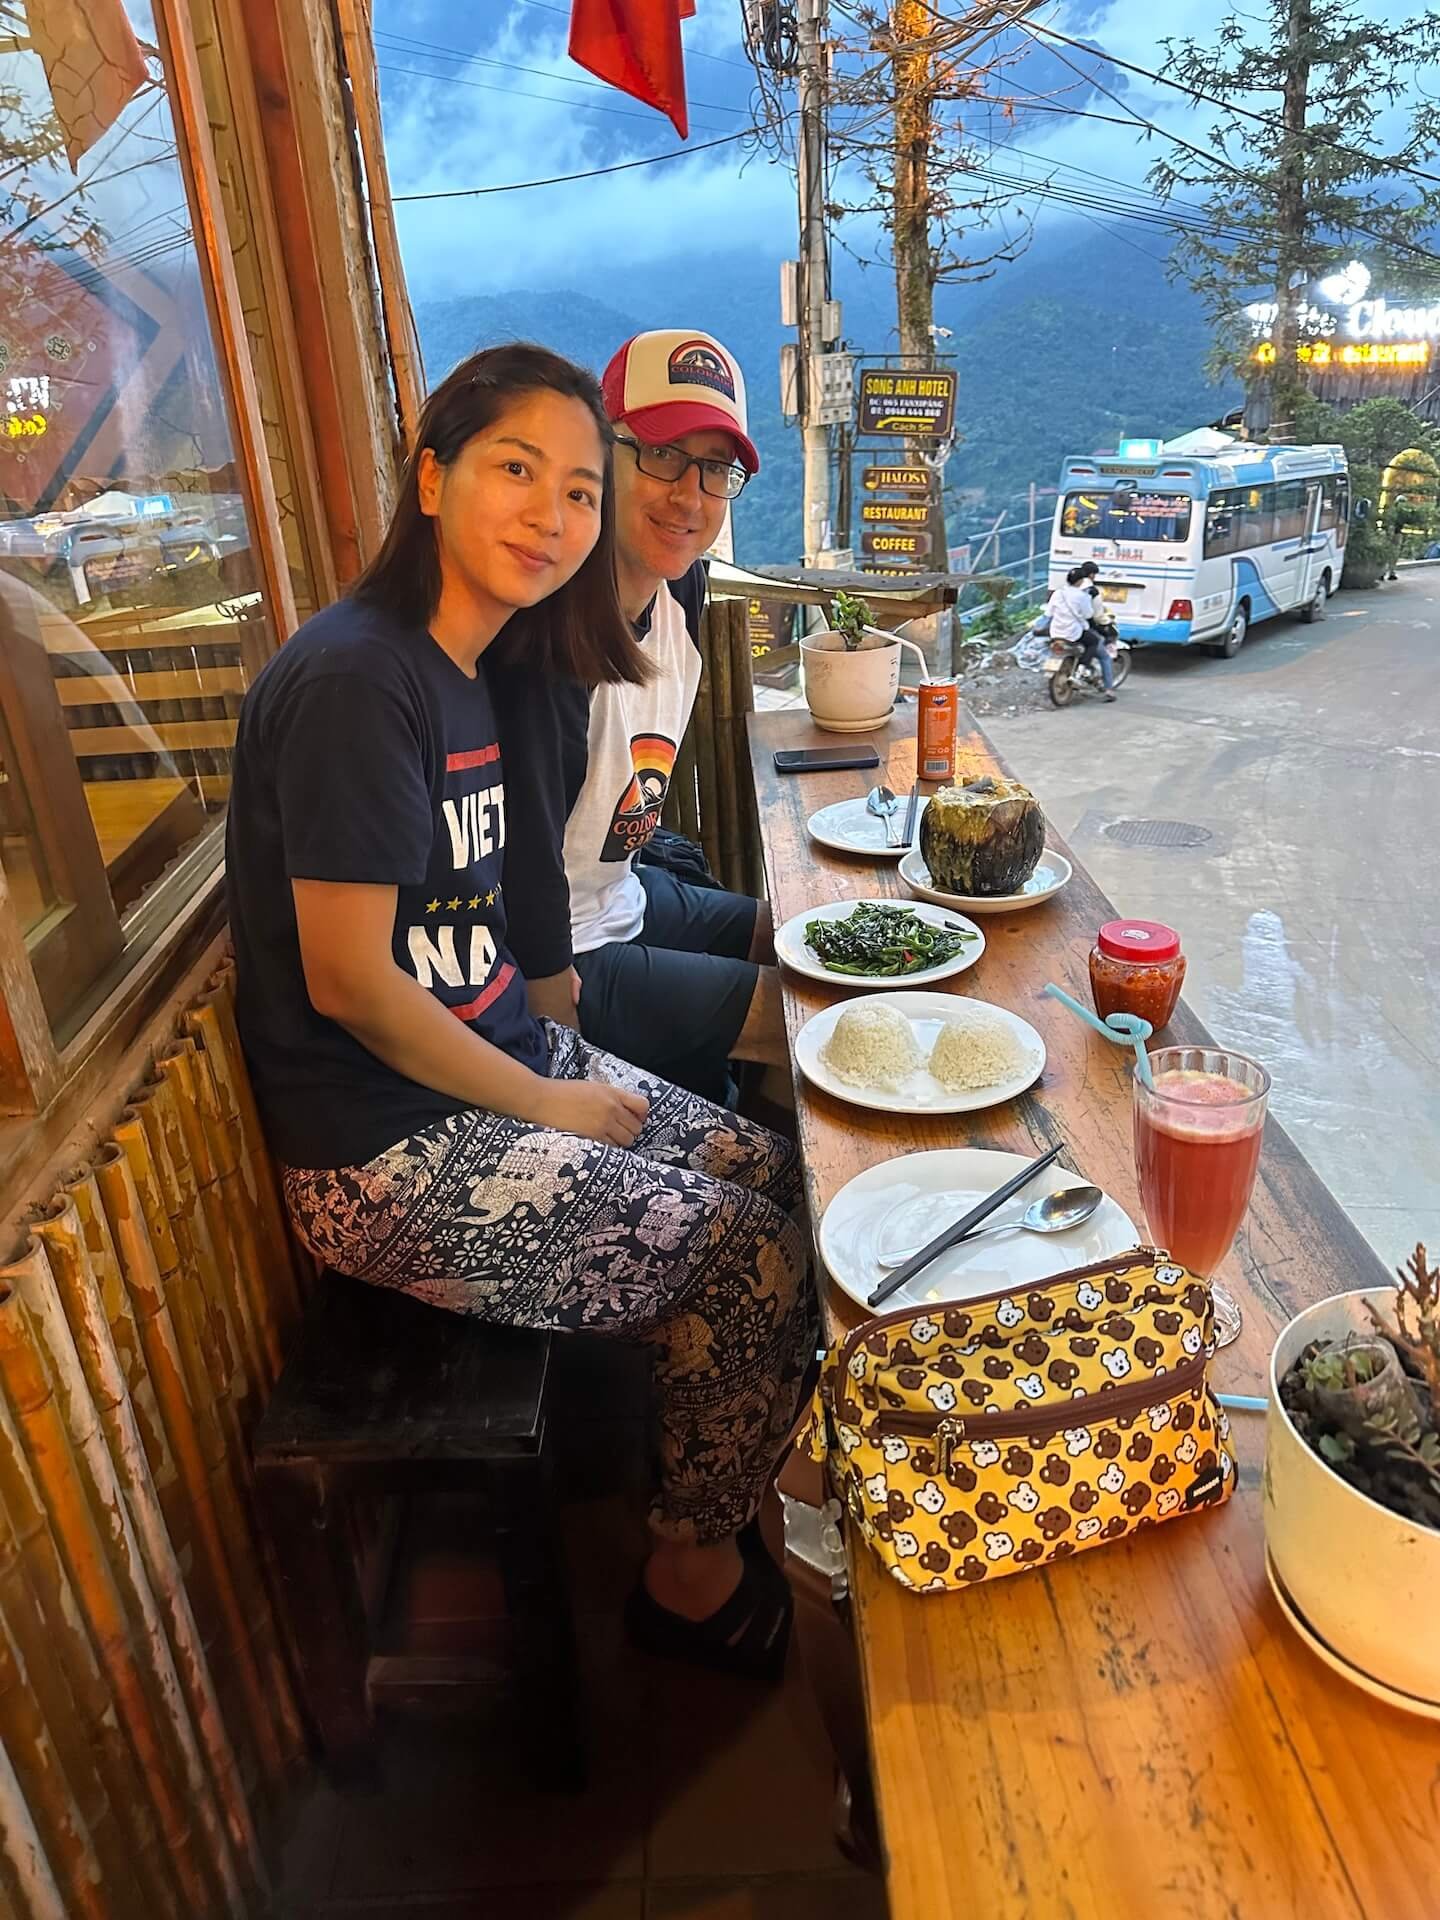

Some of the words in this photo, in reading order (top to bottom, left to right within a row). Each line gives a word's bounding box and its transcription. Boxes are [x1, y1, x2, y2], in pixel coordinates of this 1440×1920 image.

[866, 378, 894, 394] SONG
[895, 380, 917, 395] ANH
[918, 380, 949, 397] HOTEL
[881, 472, 927, 484] HALOSA
[863, 506, 928, 521] RESTAURANT
[872, 537, 916, 551] COFFEE
[442, 783, 505, 870] VIET
